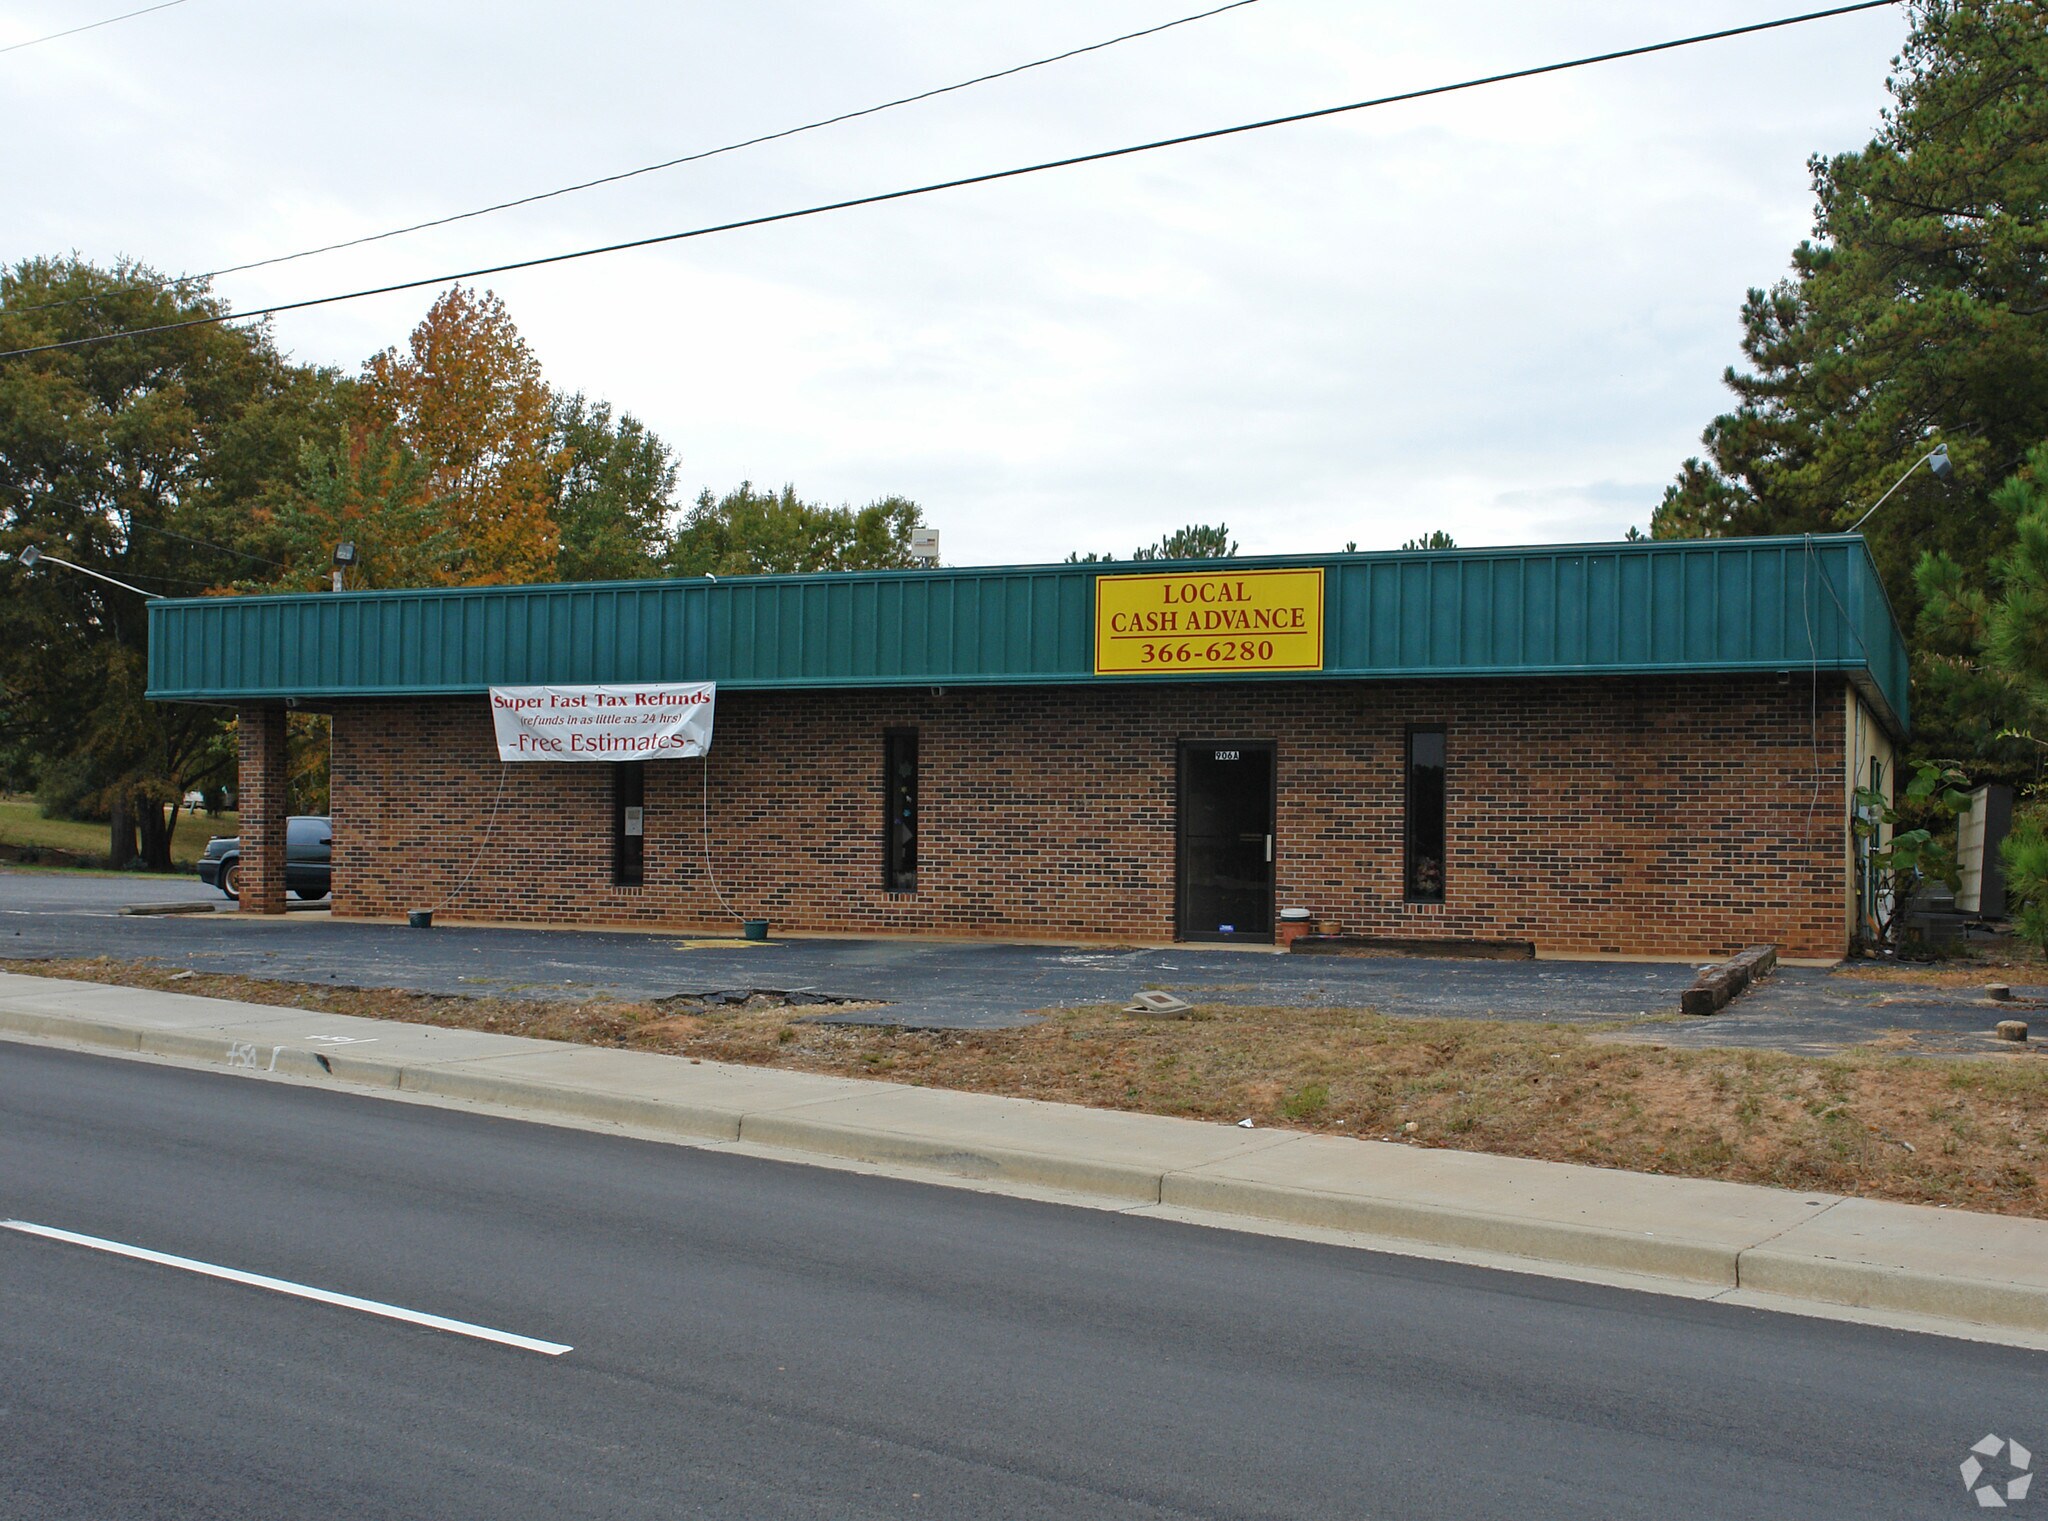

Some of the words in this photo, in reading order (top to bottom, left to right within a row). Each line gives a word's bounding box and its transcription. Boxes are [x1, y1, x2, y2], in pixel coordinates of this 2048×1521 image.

[1163, 582, 1252, 604] LOCAL
[1110, 611, 1178, 633] CASH
[1185, 607, 1306, 631] ADVANCE
[1140, 640, 1274, 664] 366-6280
[493, 695, 544, 712] Super
[550, 694, 588, 708] Fast
[594, 693, 628, 708] Tax
[634, 691, 711, 706] Refunds
[520, 715, 565, 727] (refunds
[567, 715, 578, 725] in
[580, 716, 594, 725] as
[594, 714, 621, 725] little
[623, 715, 638, 724] as
[641, 713, 656, 724] 24
[659, 713, 682, 725] hrs)
[509, 733, 563, 752] -Free
[1215, 751, 1239, 760] 906A
